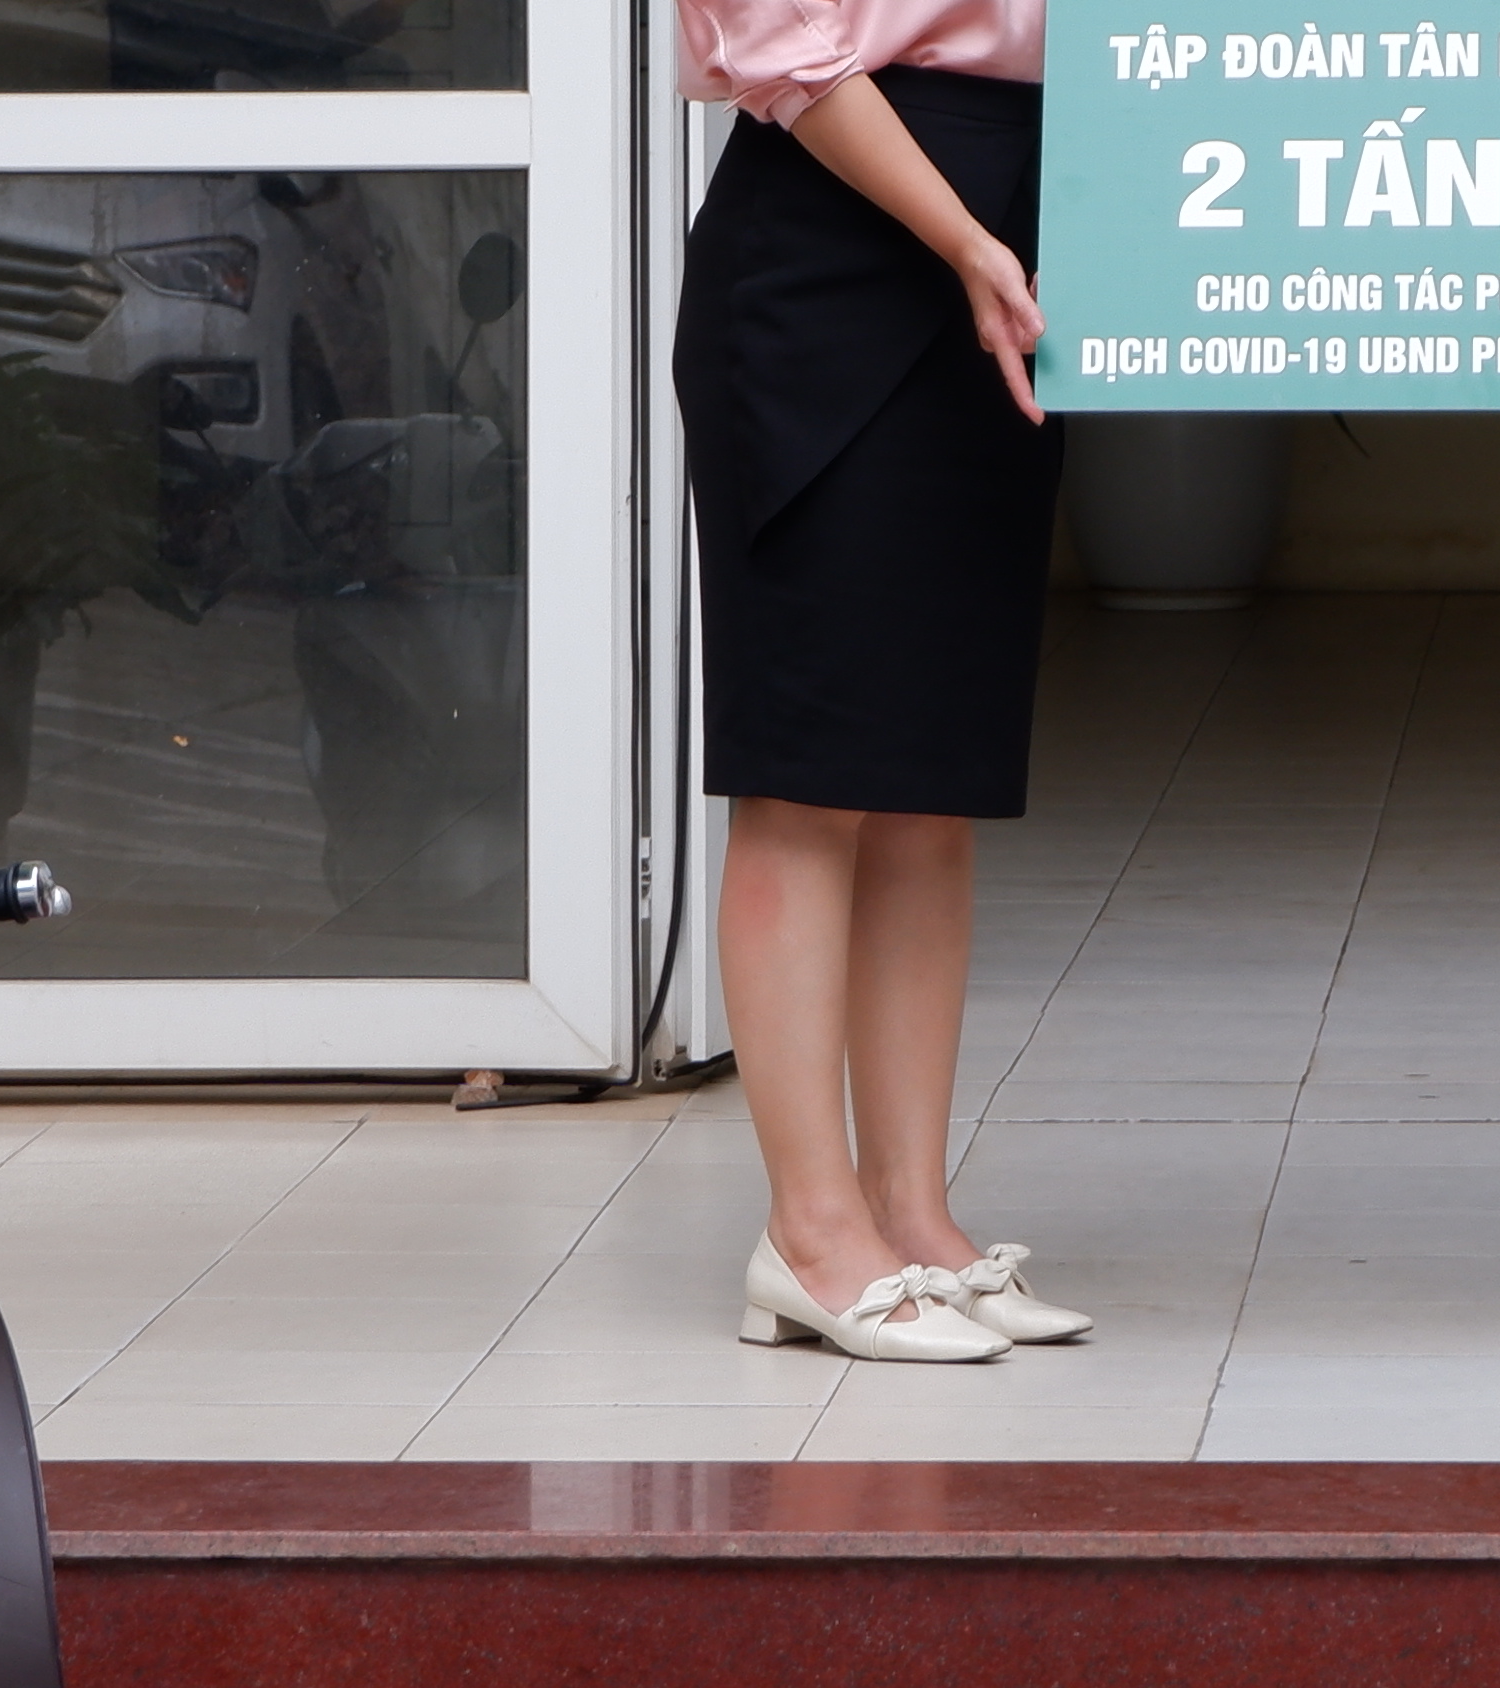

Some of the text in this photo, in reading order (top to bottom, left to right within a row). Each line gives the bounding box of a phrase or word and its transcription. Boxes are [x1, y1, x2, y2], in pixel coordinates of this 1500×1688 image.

[1110, 23, 1207, 90] TẬP
[1223, 23, 1365, 80] ĐOÀN
[1380, 22, 1479, 80] TÂN
[1177, 140, 1247, 229] 2
[1196, 273, 1271, 312] CHO
[1282, 267, 1382, 312] CÔNG
[1395, 268, 1465, 312] TÁC
[1081, 336, 1168, 383] DỊCH
[1179, 336, 1346, 376] COVID-19
[1358, 336, 1460, 376] UBND
